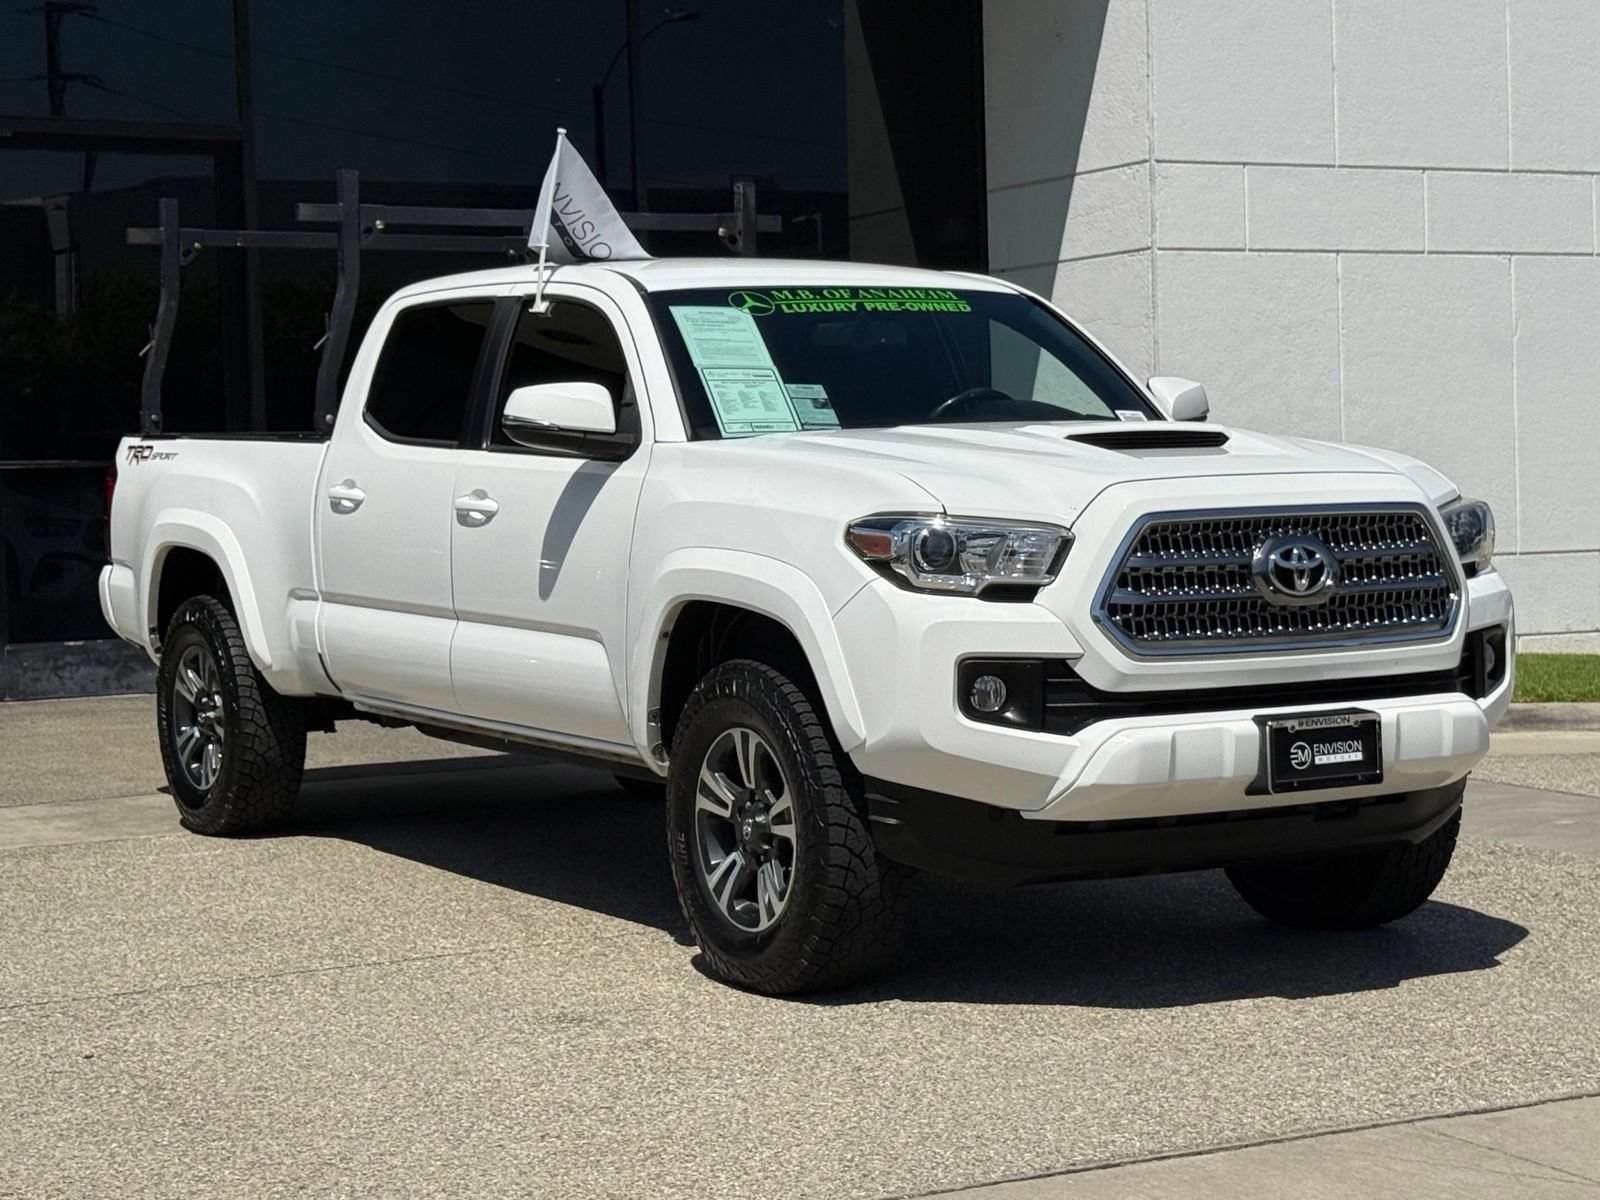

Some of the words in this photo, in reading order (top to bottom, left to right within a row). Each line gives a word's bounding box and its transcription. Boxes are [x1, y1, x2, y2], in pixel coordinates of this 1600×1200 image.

[553, 182, 612, 260] NVISIO
[771, 288, 820, 300] M.B.
[823, 289, 851, 299] OF
[858, 289, 958, 300] ANAHEIM
[781, 302, 857, 314] LUXURY
[863, 302, 972, 313] PRE-OWNED
[126, 445, 154, 467] TRD
[150, 452, 179, 460] SPORT
[1305, 716, 1351, 728] ENVISION
[1313, 740, 1363, 756] ENVISION
[1319, 753, 1359, 762] MOTORS
